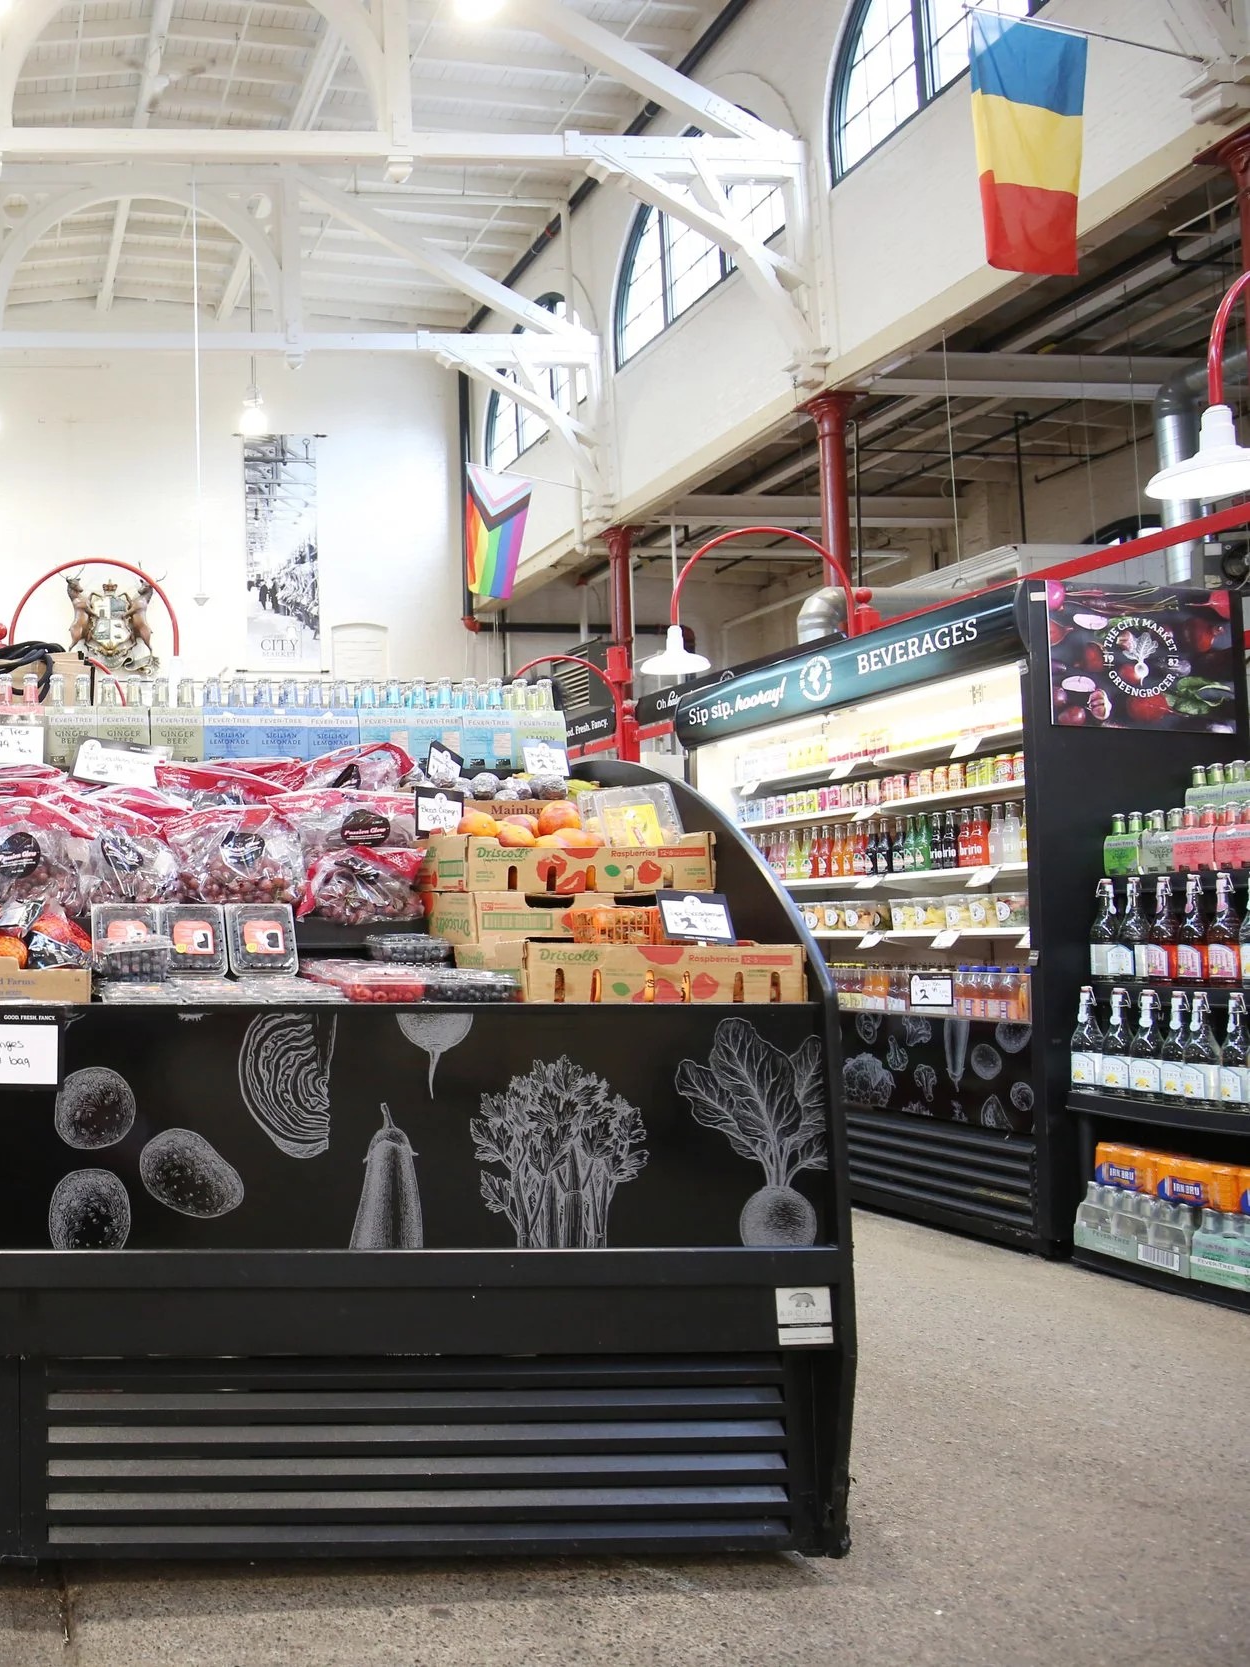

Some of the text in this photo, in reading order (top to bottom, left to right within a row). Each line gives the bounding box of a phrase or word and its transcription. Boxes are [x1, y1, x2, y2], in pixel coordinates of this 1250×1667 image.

[1104, 618, 1178, 652] THE CITY MARKET
[260, 639, 299, 651] CITY
[857, 618, 979, 675] BEVERAGES
[1103, 655, 1114, 663] 19
[1168, 658, 1179, 667] 82
[1109, 670, 1176, 698] GREENGROCER
[656, 698, 666, 710] Oh
[689, 705, 708, 726] Sip
[711, 700, 734, 720] sip,
[734, 677, 786, 713] hooray!
[575, 718, 608, 735] Fresh. Fancy.
[160, 730, 194, 738] GINGER
[491, 805, 544, 815] Mainlan
[611, 850, 656, 858] Raspberries
[539, 948, 602, 963] Driscoll's
[689, 954, 739, 964] Raspberries
[7, 977, 36, 986] Farms
[9, 1056, 31, 1068] bag
